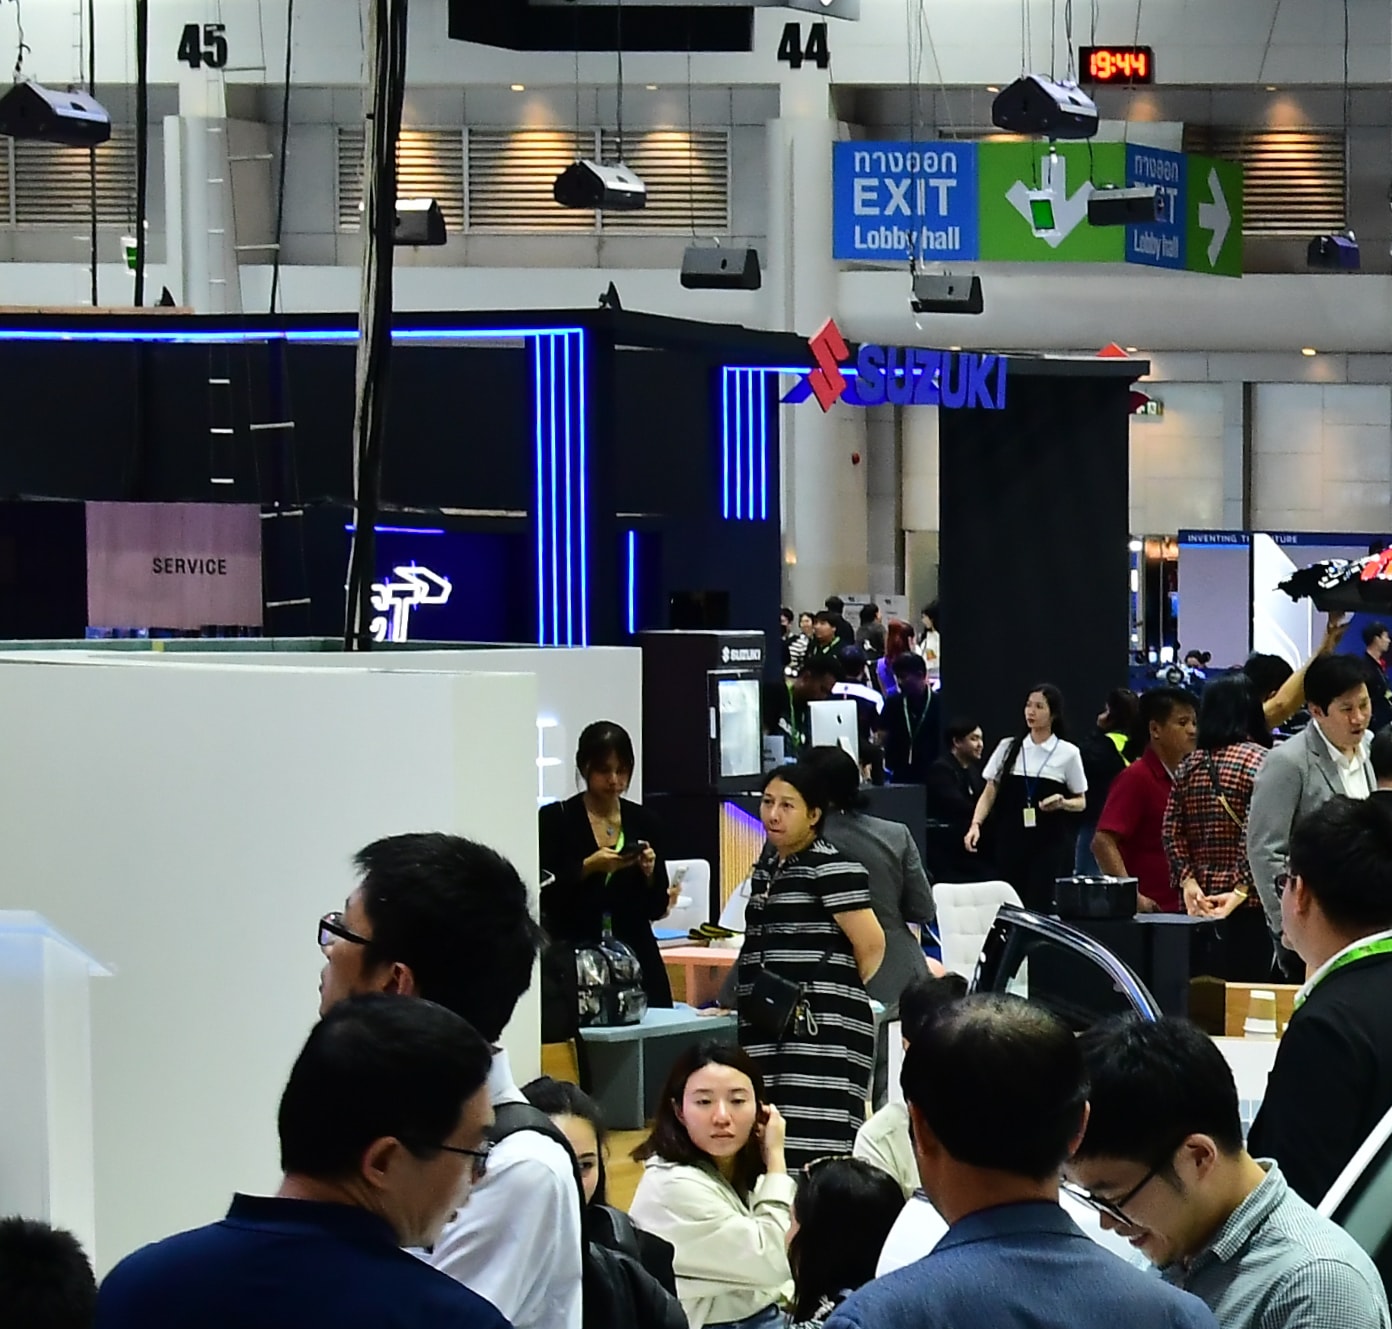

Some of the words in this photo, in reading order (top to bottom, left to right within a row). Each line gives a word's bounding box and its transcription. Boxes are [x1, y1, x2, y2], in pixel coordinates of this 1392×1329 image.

[177, 23, 227, 69] 45
[777, 22, 830, 69] 44
[1090, 50, 1146, 78] 19:44
[853, 149, 958, 174] ทางออก
[853, 177, 957, 217] EXIT
[855, 224, 919, 256] Lobby
[922, 226, 960, 252] hall
[856, 343, 1008, 410] SUZUKI
[1272, 534, 1298, 544] TURE
[152, 557, 228, 576] SERVICE
